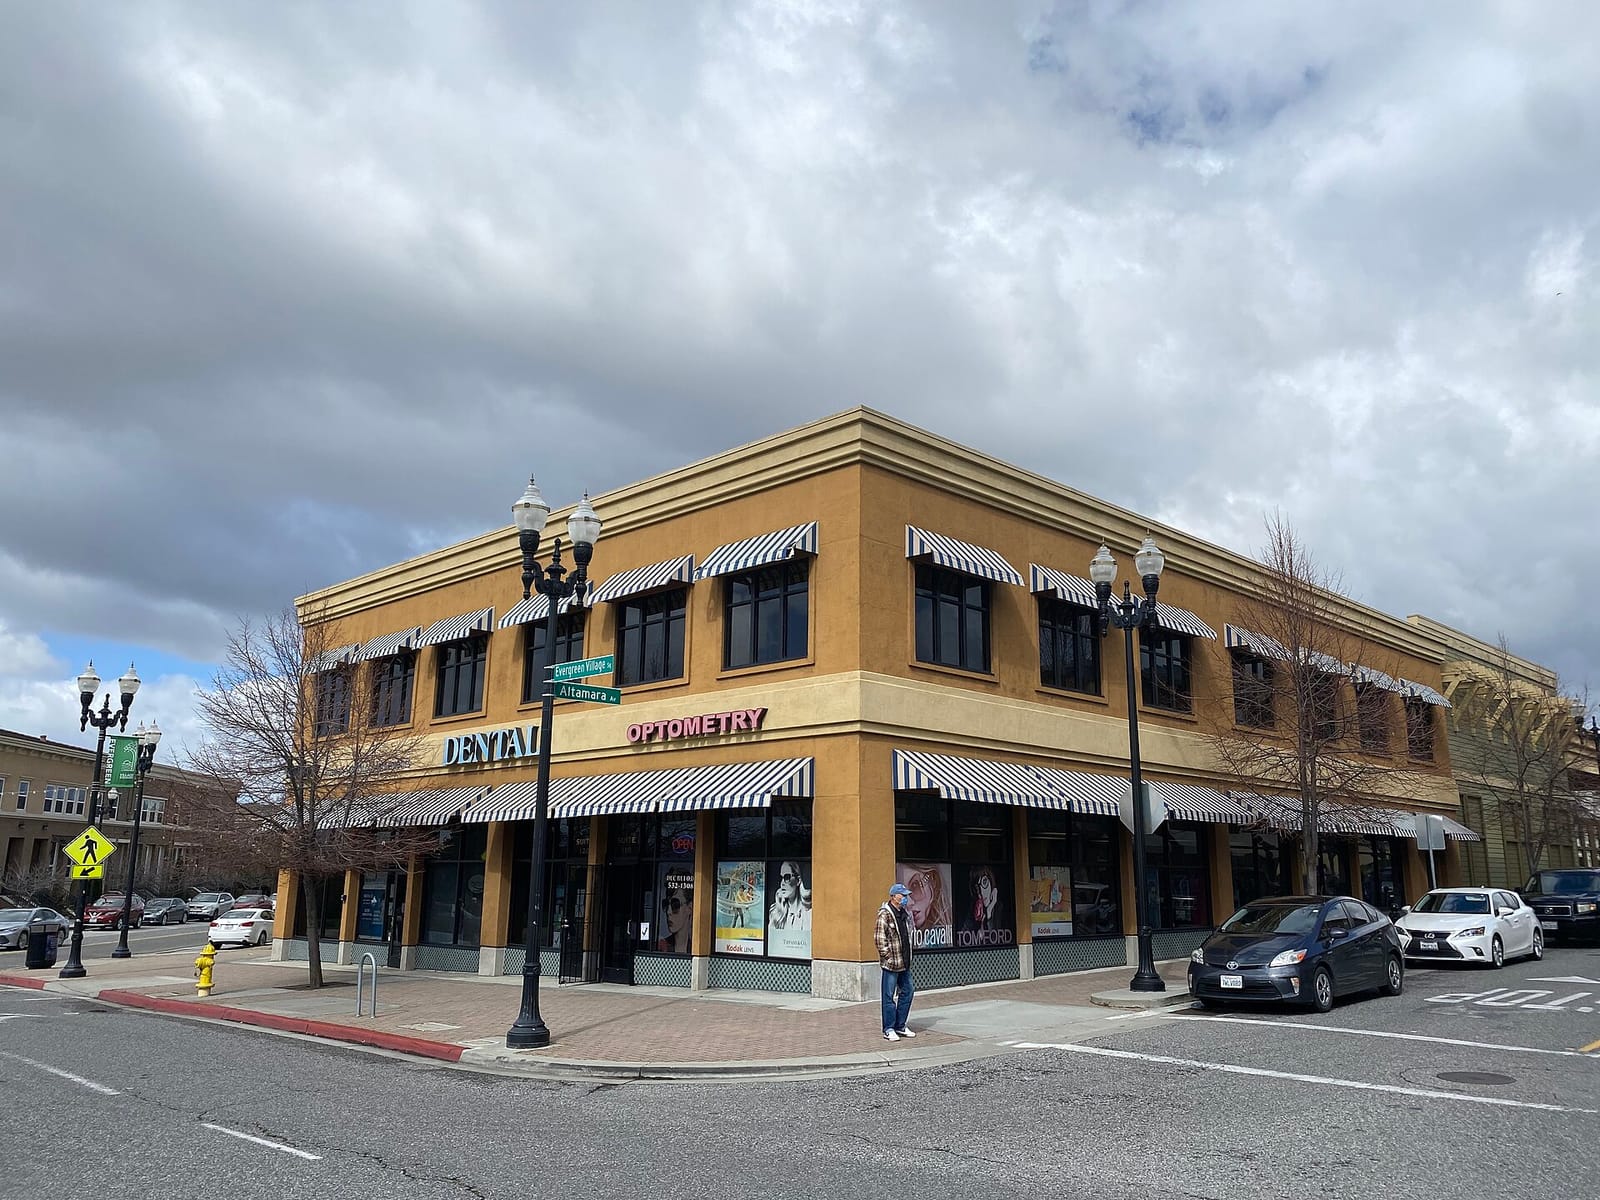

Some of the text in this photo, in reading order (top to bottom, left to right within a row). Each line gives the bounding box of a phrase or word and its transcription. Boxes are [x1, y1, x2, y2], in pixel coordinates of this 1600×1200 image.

[555, 663, 585, 678] Evergreen
[585, 660, 606, 673] Village
[559, 685, 607, 701] Altamara
[627, 708, 765, 742] OPTOMETRY
[443, 725, 541, 766] DENTAL
[104, 738, 116, 785] EVERGREEN
[576, 838, 590, 846] SUIT
[672, 839, 694, 850] OPEN
[924, 924, 953, 945] cavalli
[957, 928, 1012, 946] TOM FORD
[726, 943, 743, 953] Kodak
